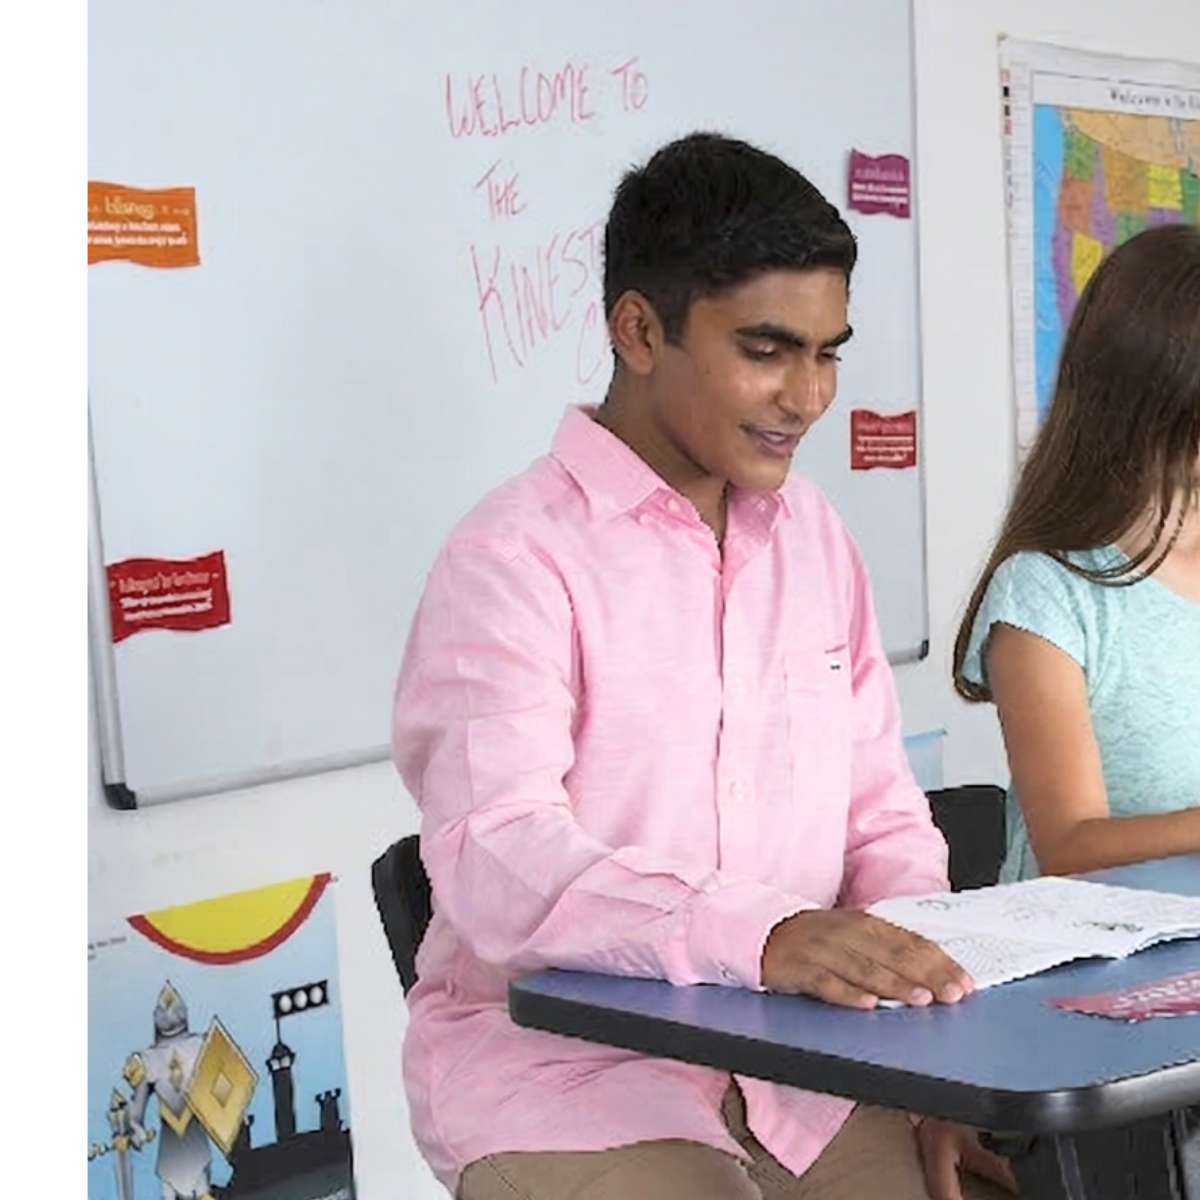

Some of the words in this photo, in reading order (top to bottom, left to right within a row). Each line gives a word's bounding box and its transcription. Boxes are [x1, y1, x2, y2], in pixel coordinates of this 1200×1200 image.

[445, 62, 595, 138] WELCOME
[611, 56, 648, 111] TO
[474, 158, 527, 220] THE
[469, 219, 606, 385] KINEST
